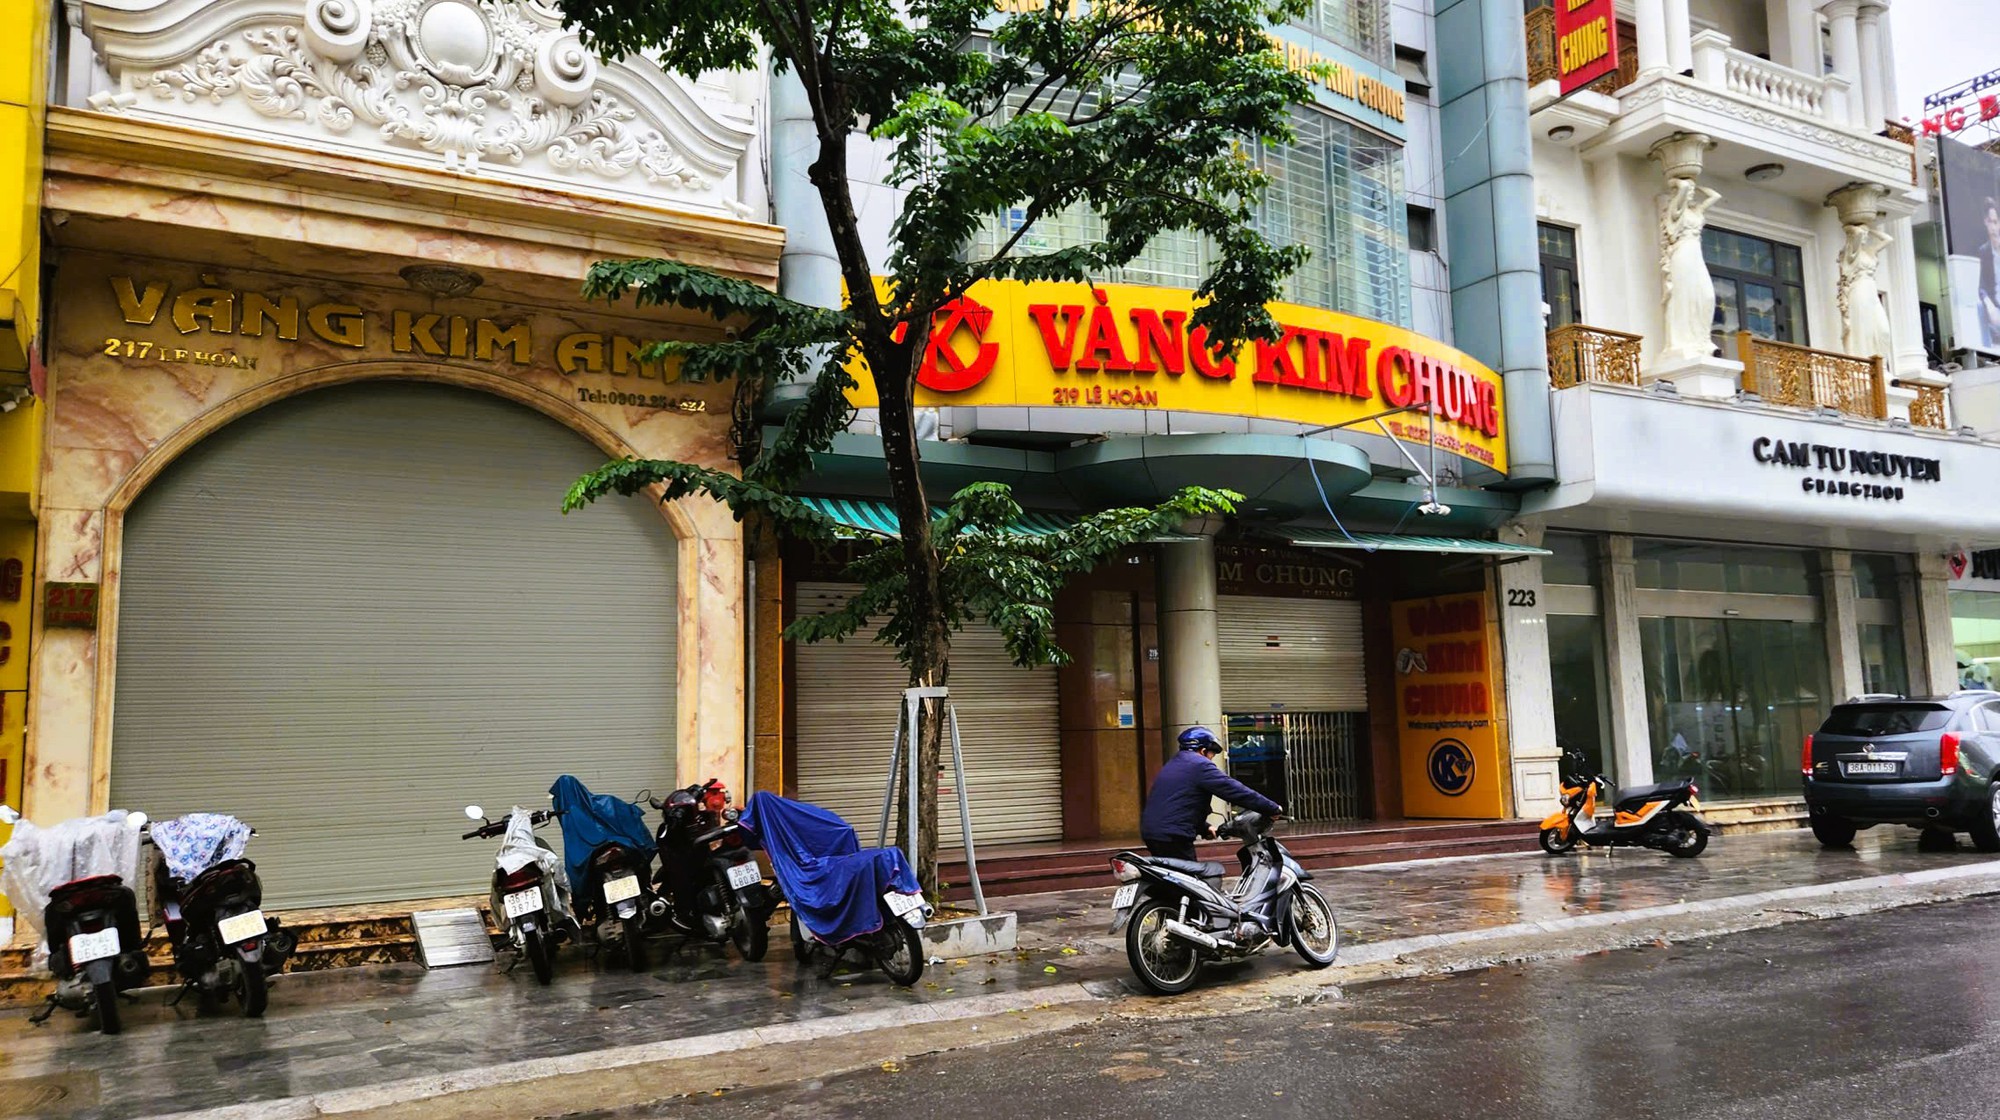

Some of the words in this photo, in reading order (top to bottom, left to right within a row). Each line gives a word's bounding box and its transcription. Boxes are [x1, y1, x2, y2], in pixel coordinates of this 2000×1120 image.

[1560, 15, 1609, 76] CHUNG
[1357, 73, 1406, 124] CHUNG
[108, 271, 367, 349] VÀNG
[391, 309, 532, 365] KIM
[103, 338, 154, 360] 217
[1027, 287, 1237, 381] VÀNG
[1252, 324, 1374, 401] KIM
[1375, 345, 1499, 438] CHUNG
[1052, 388, 1080, 406] 219
[1085, 384, 1104, 406] LÊ
[1108, 385, 1159, 408] HOÀN
[1752, 436, 1811, 469] CAM
[1811, 444, 1848, 473] TU
[1847, 449, 1943, 483] NGUYEN
[1802, 477, 1904, 501] GUANGZHOU
[1255, 564, 1355, 588] CHUNG
[47, 588, 97, 609] 217
[1507, 588, 1537, 608] 223
[1426, 640, 1484, 674] KIM
[1403, 681, 1488, 716] CHUNG
